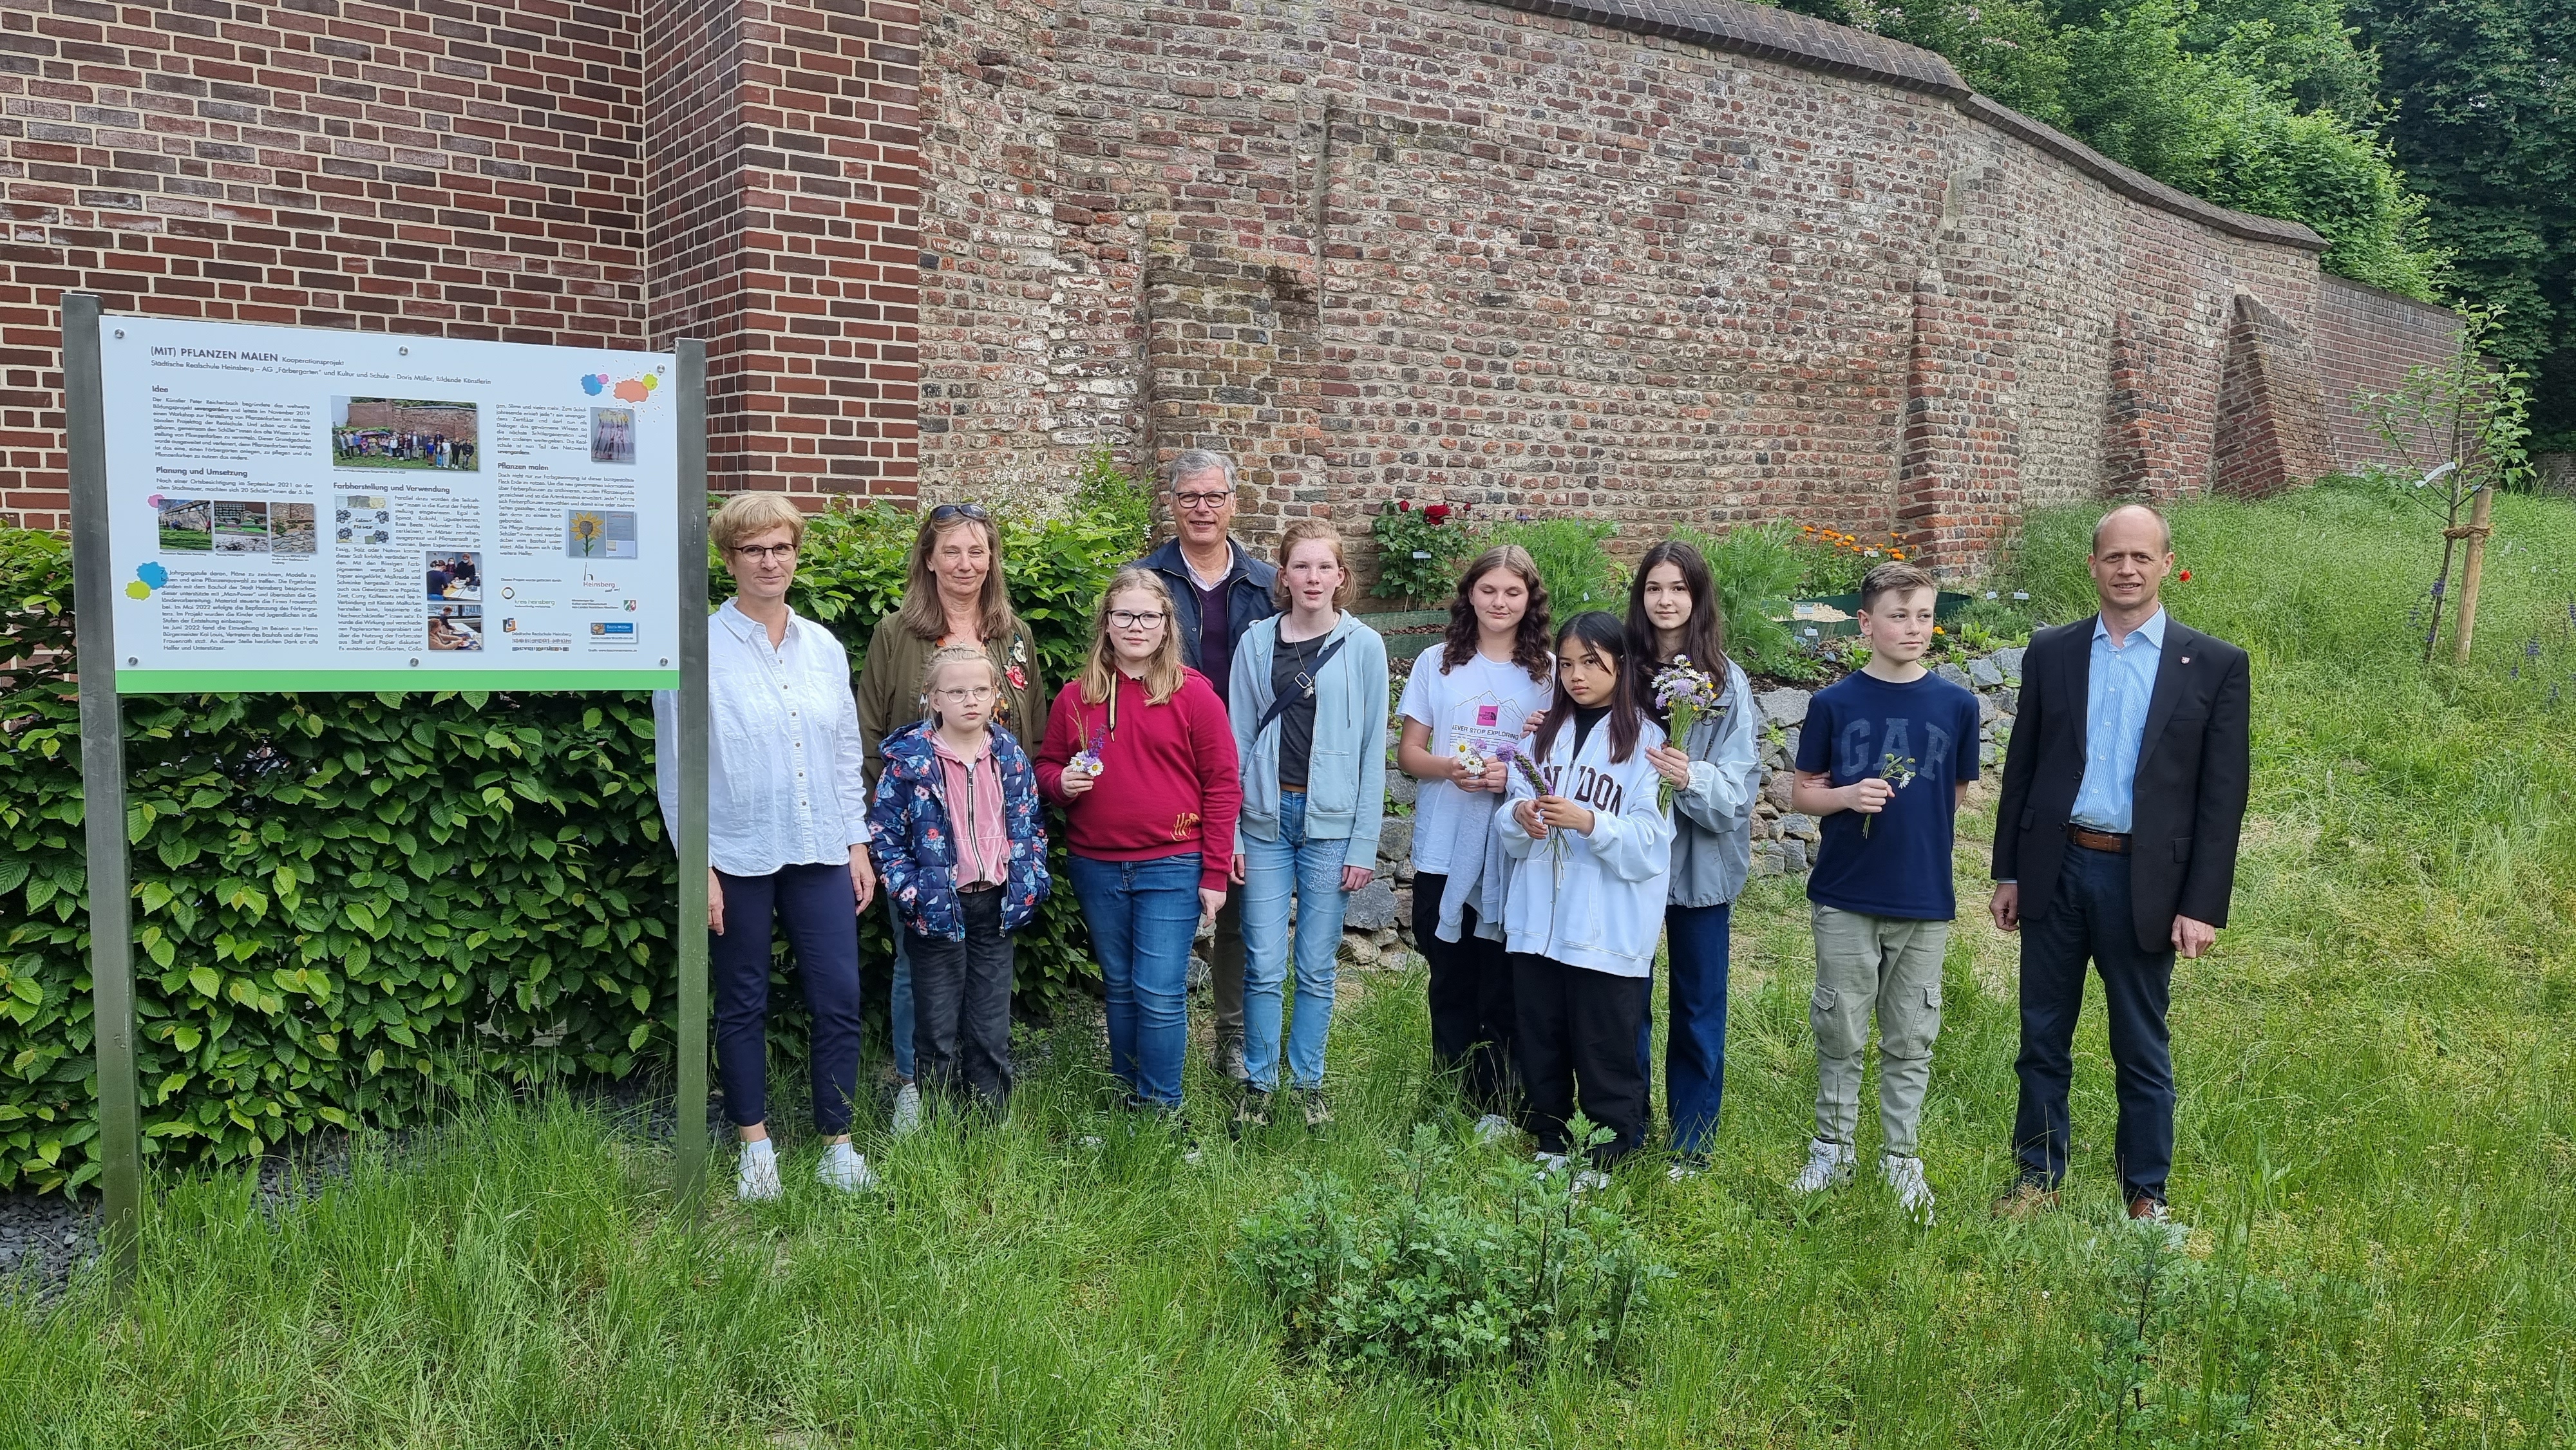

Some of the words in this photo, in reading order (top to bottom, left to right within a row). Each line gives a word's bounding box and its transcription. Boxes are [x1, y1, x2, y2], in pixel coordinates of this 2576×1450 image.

[151, 346, 176, 357] (MIT)
[181, 348, 237, 359] PFLANZEN
[241, 352, 278, 361] MALEN
[281, 357, 345, 366] Kooperationsprojekt
[221, 364, 254, 372] Heinsberg
[156, 466, 187, 475] Planung
[206, 468, 248, 478] Umsetzung
[333, 482, 388, 491] Farbherstellung
[406, 485, 450, 494] Verwendung
[1486, 730, 1519, 740] EXPLORING
[1841, 717, 1951, 782] GAP
